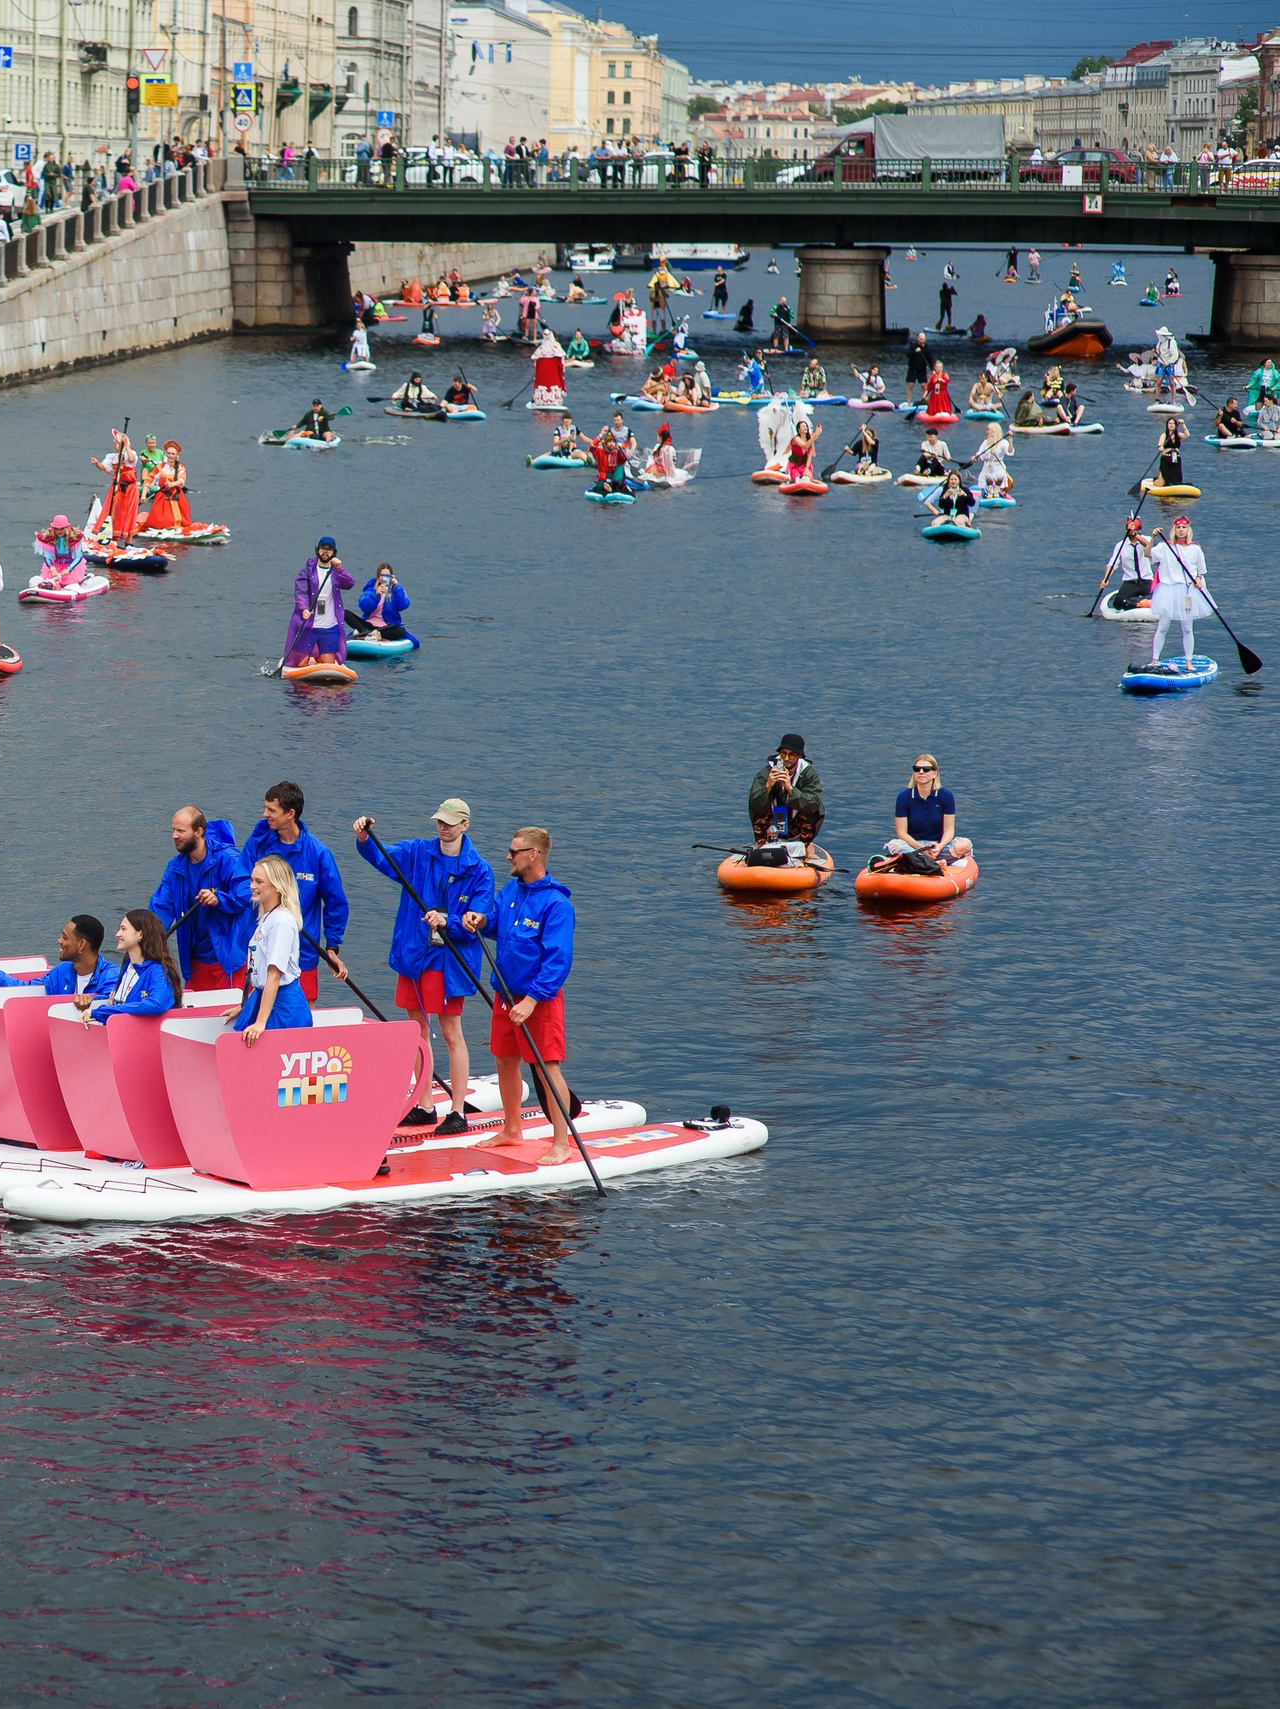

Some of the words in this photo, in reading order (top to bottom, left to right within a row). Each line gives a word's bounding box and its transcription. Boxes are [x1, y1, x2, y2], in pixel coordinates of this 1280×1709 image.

[237, 118, 248, 127] 40
[280, 1050, 343, 1077] УТРО
[277, 1074, 348, 1107] ТНТ
